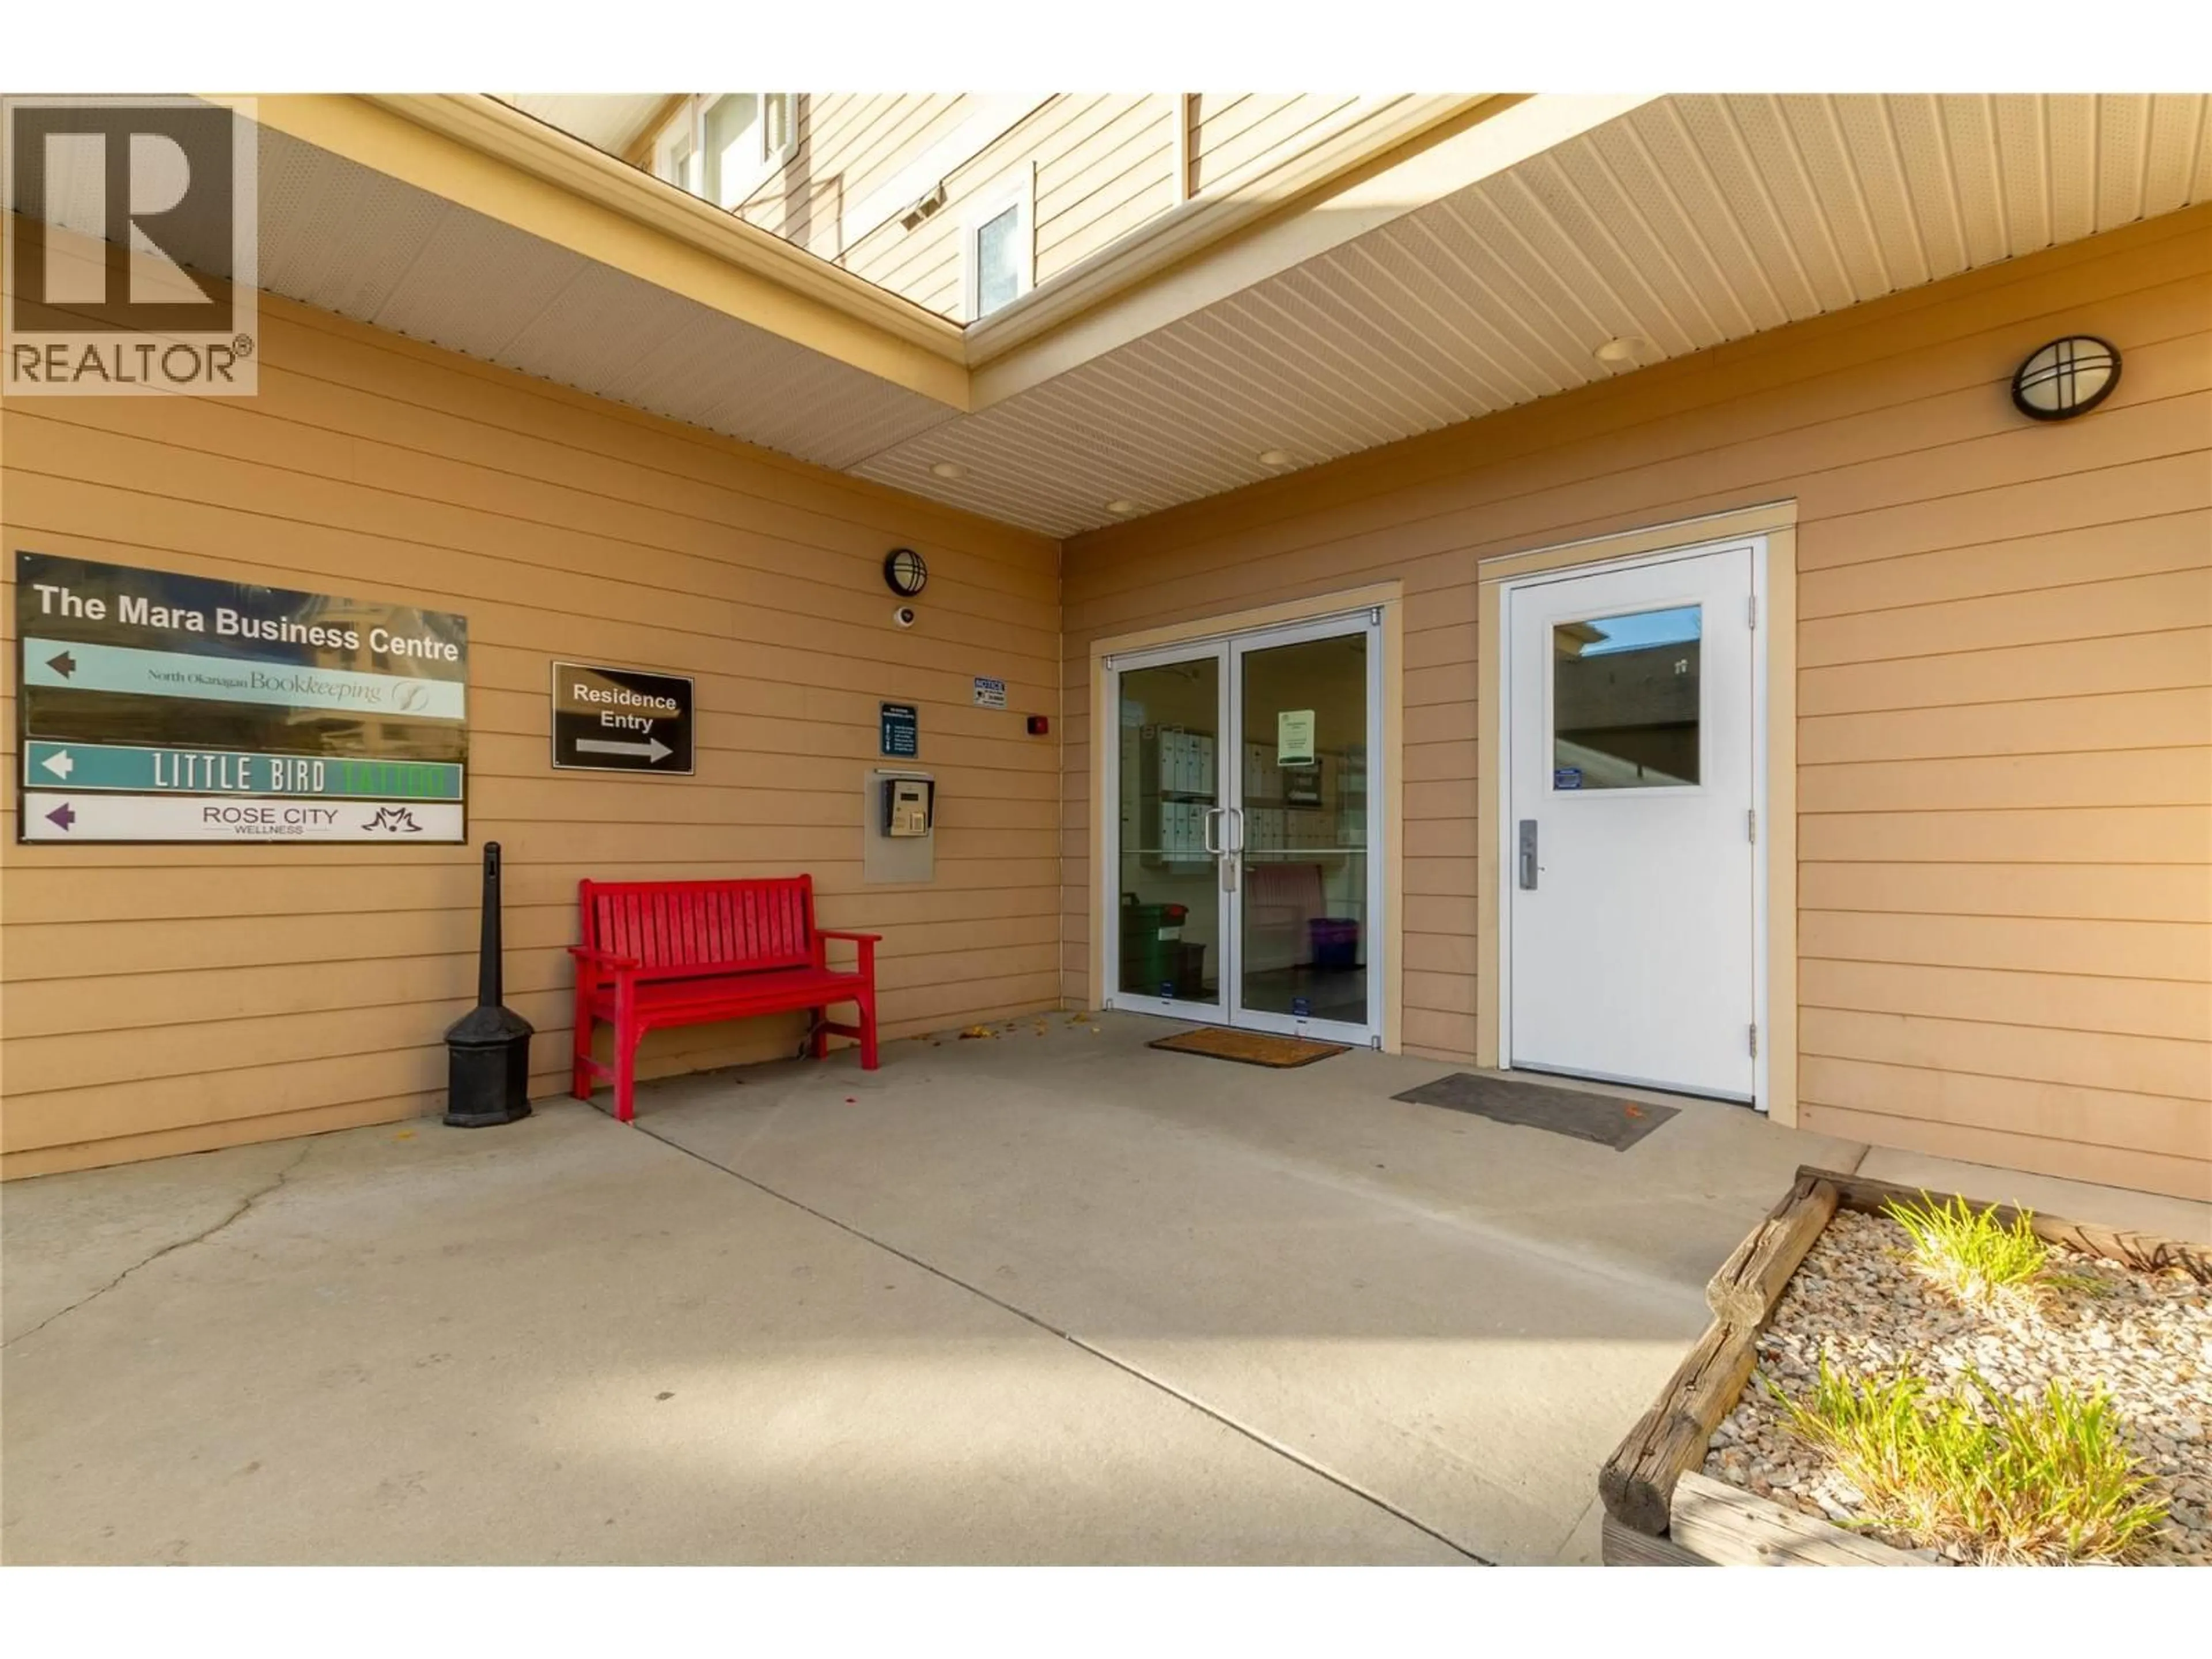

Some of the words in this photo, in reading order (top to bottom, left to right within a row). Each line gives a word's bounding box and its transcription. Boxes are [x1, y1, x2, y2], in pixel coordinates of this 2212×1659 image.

[33, 584, 107, 620] The
[119, 594, 204, 632] Mara
[215, 608, 360, 650] Business
[369, 628, 459, 661] Centre
[148, 669, 185, 683] North
[187, 672, 248, 689] Okanagan
[250, 671, 382, 704] Bookkeeping
[573, 683, 677, 710] Residence
[601, 710, 653, 734] Entry
[152, 752, 252, 790] LITTLE
[269, 758, 324, 793] BIRD
[203, 807, 276, 824] ROSE
[283, 808, 339, 824] CITY
[234, 825, 304, 835] WELLNESS
